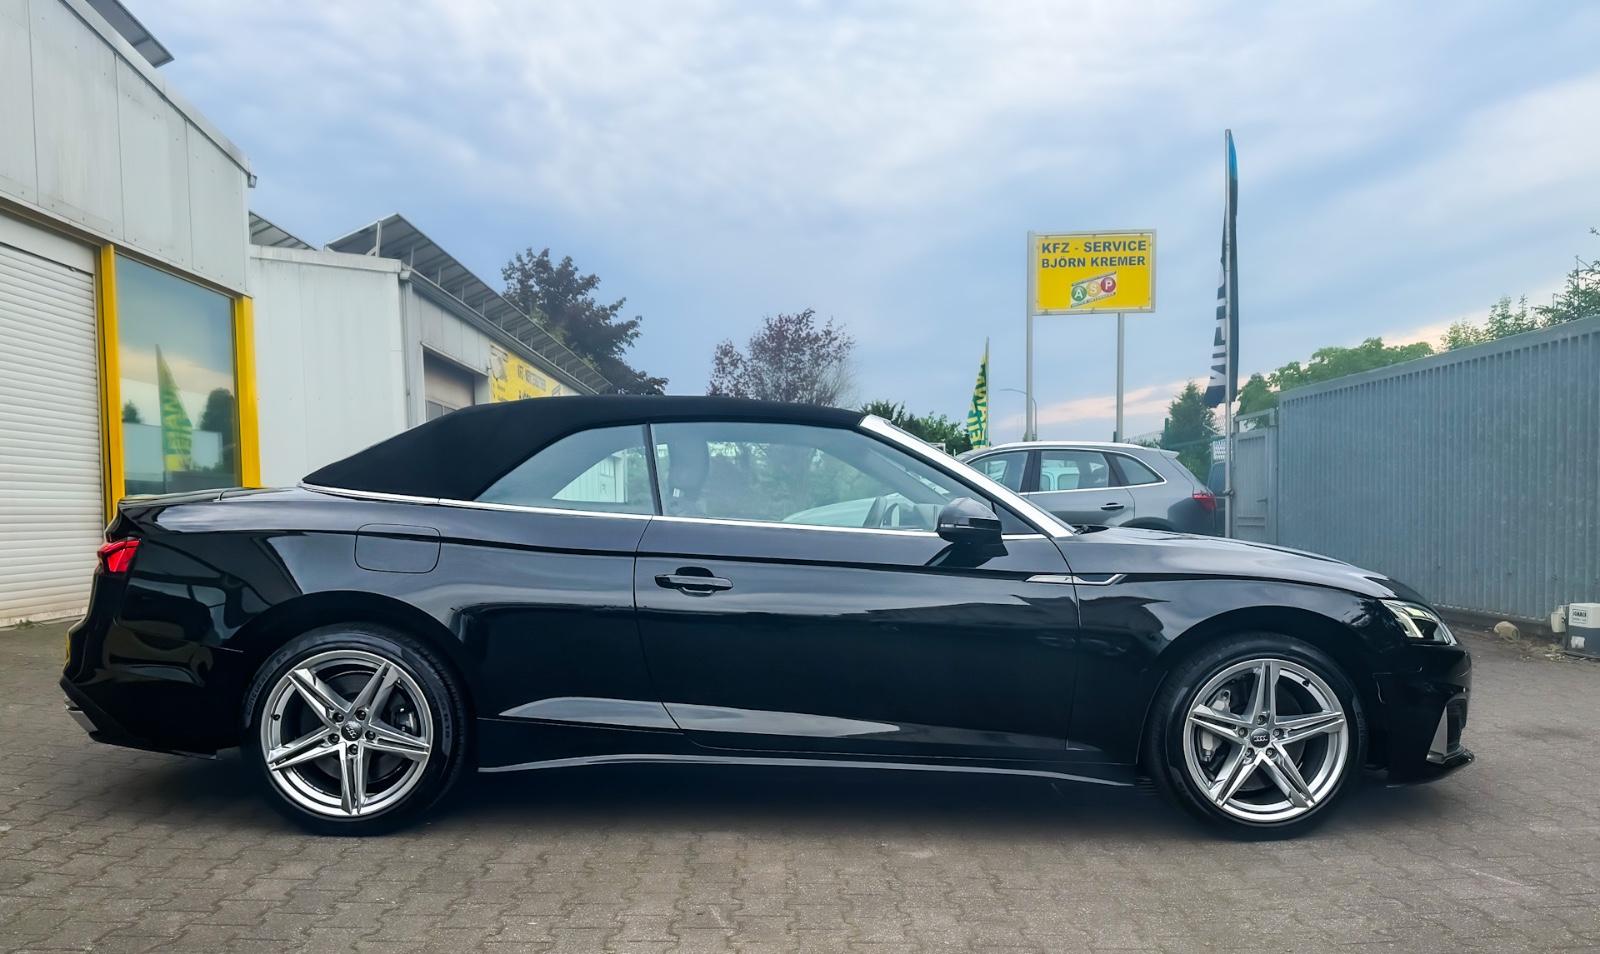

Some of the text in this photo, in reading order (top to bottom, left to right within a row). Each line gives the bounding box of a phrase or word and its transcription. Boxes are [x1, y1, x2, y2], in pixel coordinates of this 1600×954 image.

[1041, 242, 1070, 254] KFZ
[1083, 240, 1147, 253] SERVICE
[1041, 255, 1146, 268] BJÖRN KREMER
